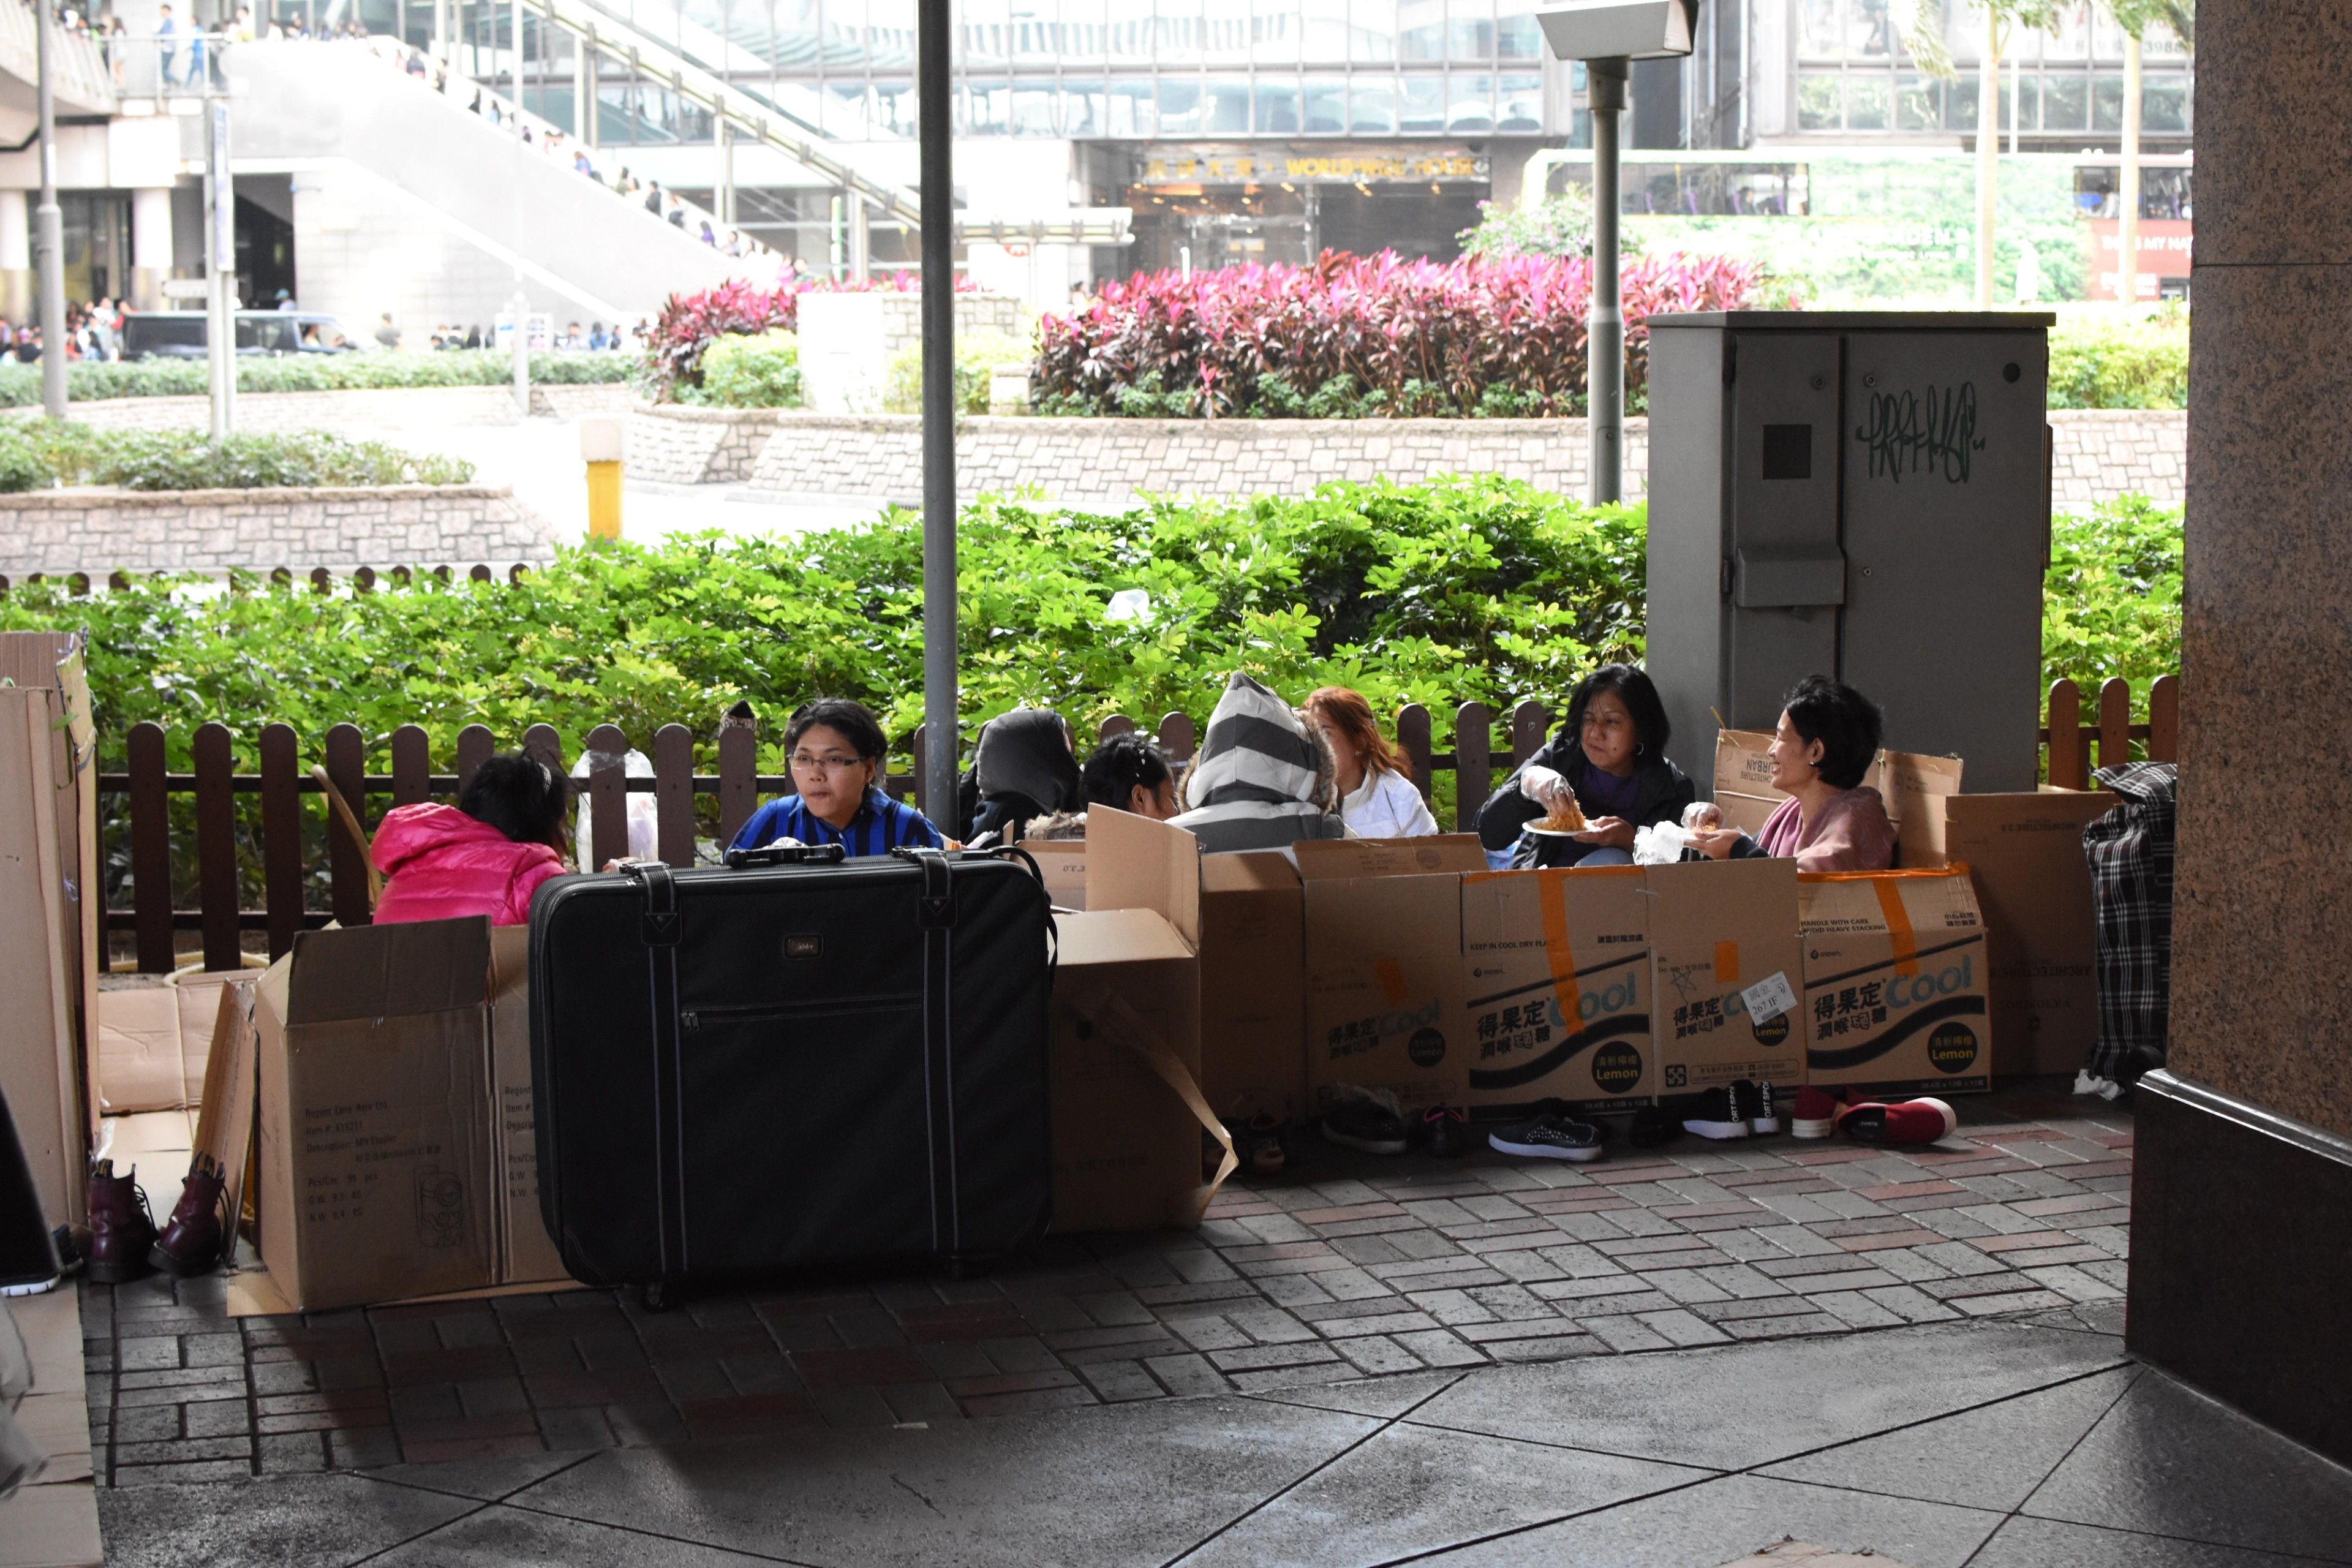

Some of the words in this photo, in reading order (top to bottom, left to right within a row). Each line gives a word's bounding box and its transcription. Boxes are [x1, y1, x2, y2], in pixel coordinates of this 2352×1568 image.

[1414, 157, 1475, 176] HOUSE
[1740, 771, 1773, 783] CHITECTURE
[1885, 954, 1972, 1009] Cool
[1752, 1001, 1766, 1014] 267
[1477, 1000, 1546, 1041] 得果定
[1756, 1027, 1787, 1036] Lemon
[1932, 1049, 1973, 1060] Lemon
[1597, 1069, 1638, 1080] Lemon
[306, 1107, 331, 1118] Regent
[506, 1104, 522, 1113] Item
[306, 1126, 323, 1136] Item
[370, 1134, 396, 1145] Stapler
[364, 1173, 378, 1183] pcs
[353, 1207, 363, 1218] KG
